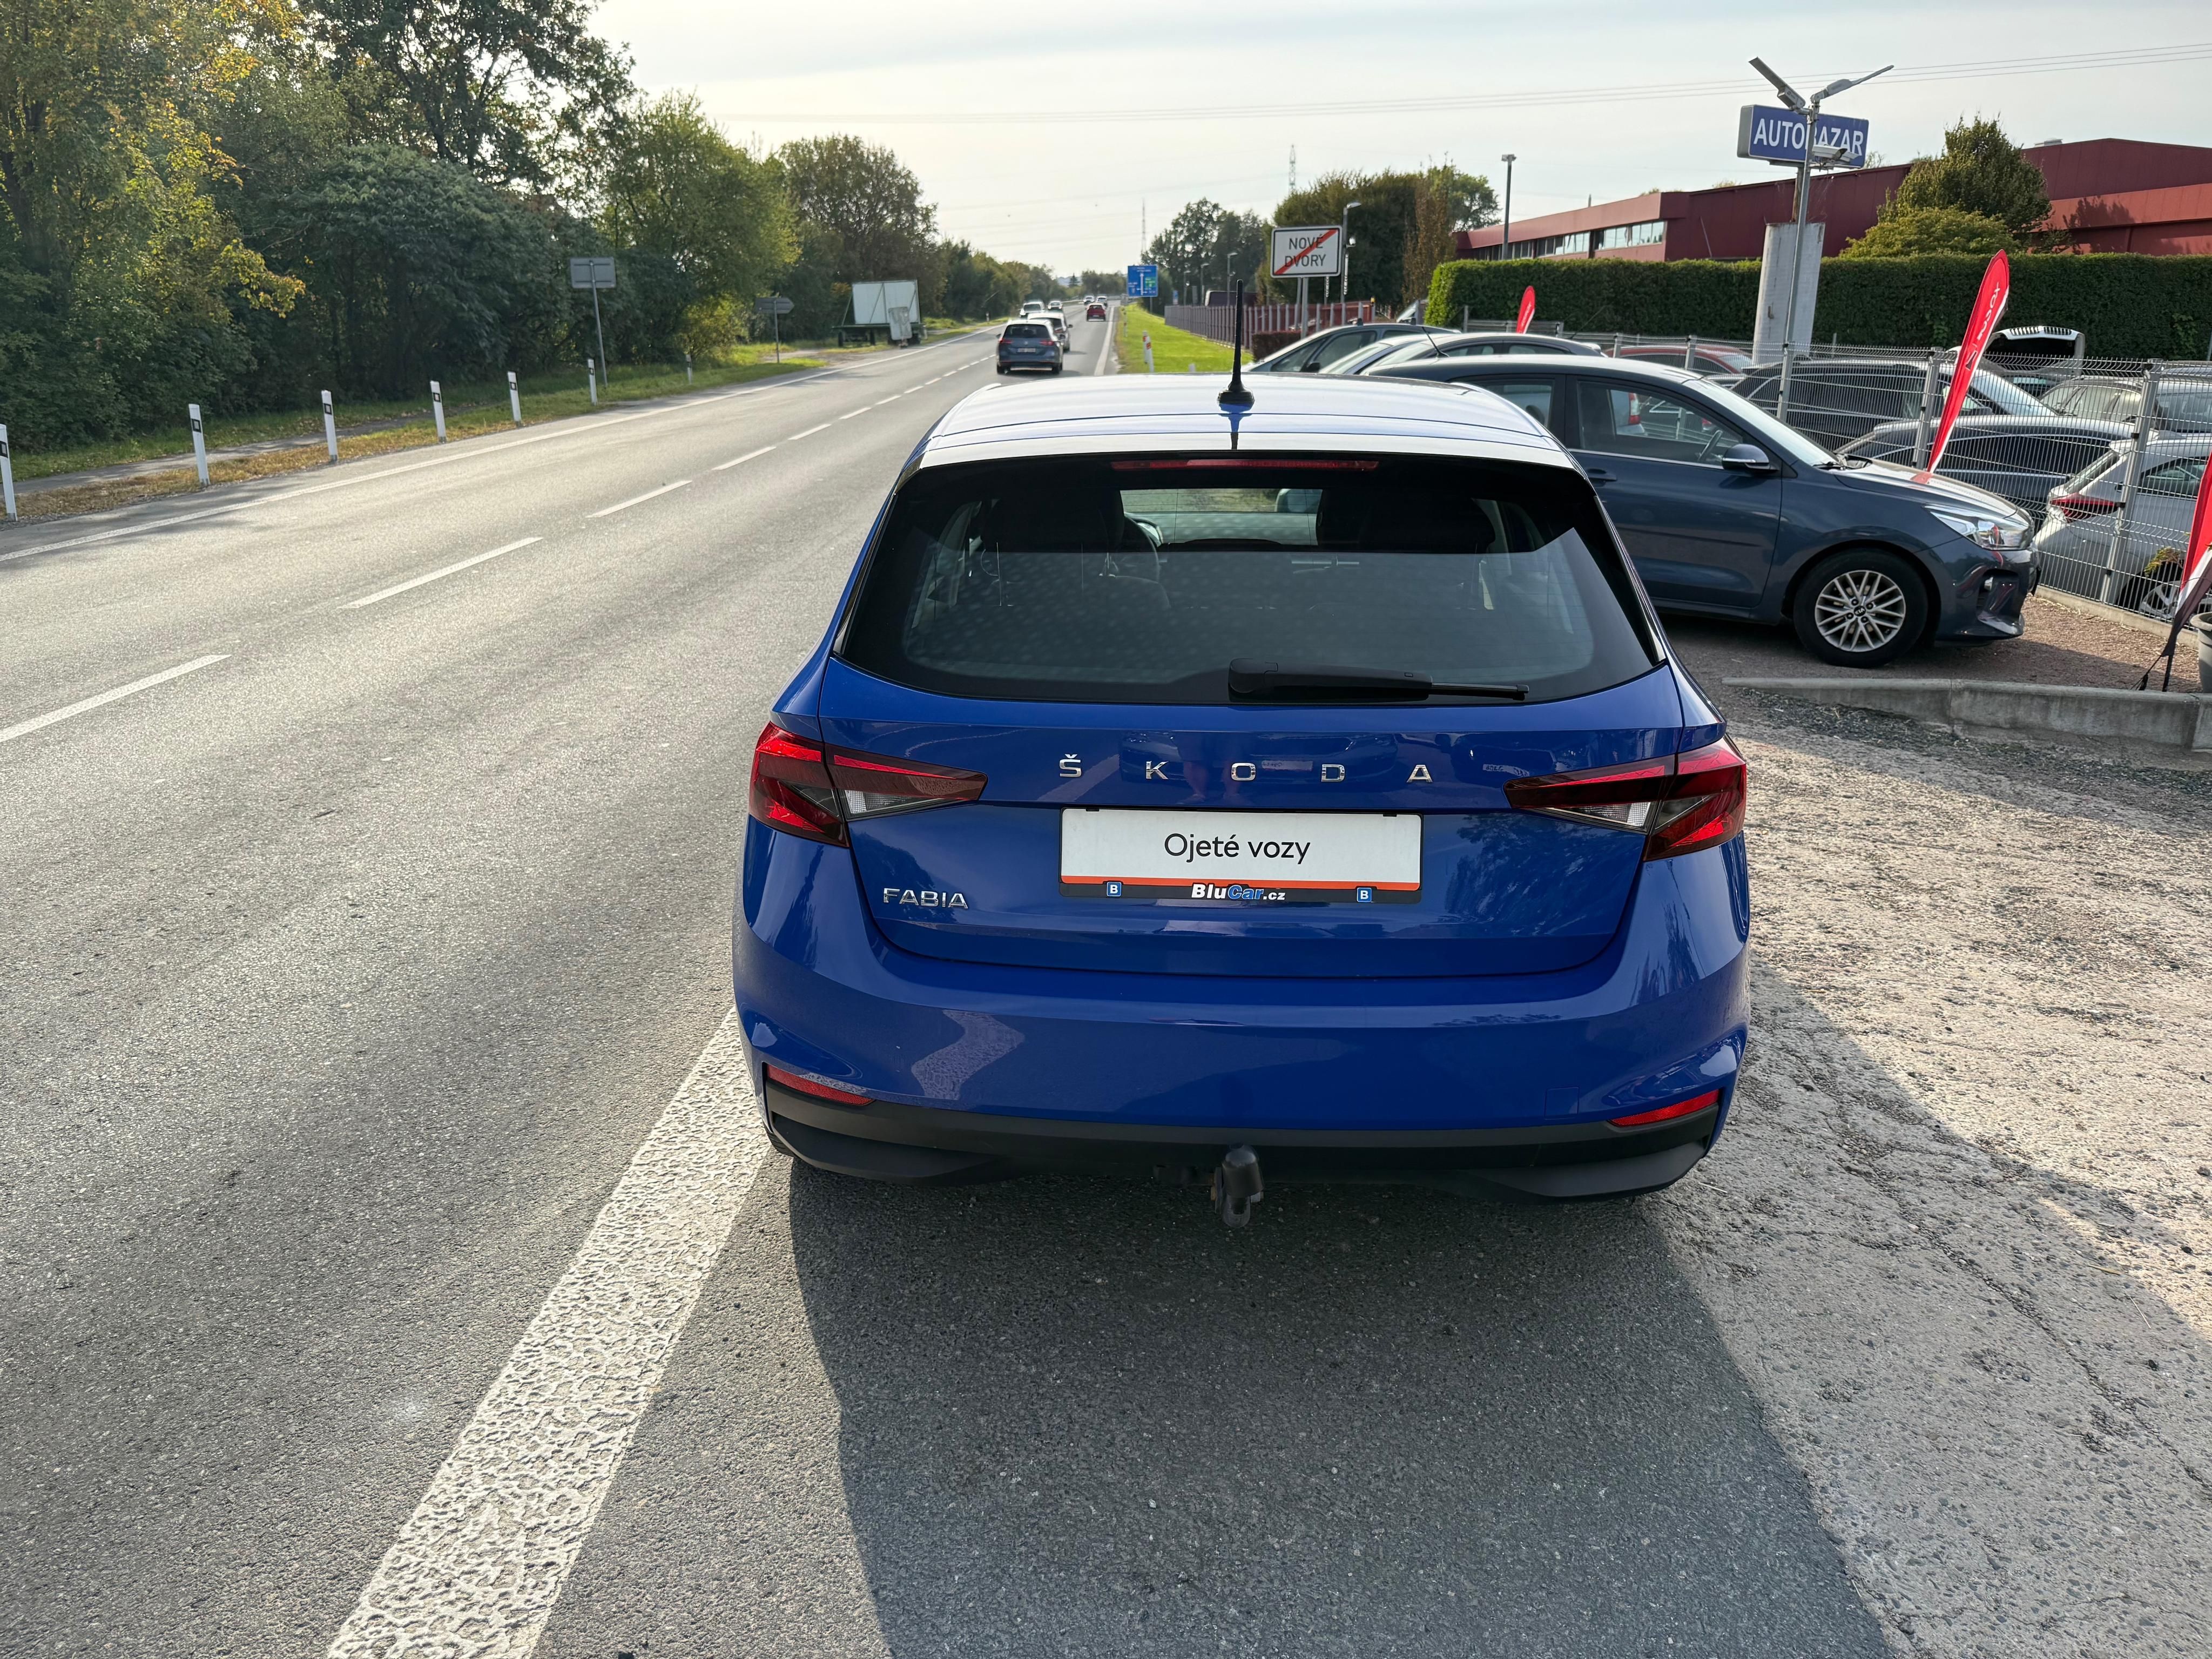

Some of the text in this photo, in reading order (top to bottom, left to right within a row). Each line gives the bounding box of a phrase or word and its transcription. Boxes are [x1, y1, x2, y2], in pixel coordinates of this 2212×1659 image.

[1289, 234, 1323, 249] NOVÉ
[1284, 254, 1326, 267] DVORY
[1164, 833, 1311, 865] Ojeté vozy
[1110, 884, 1118, 894] B
[1191, 883, 1286, 901] BluCar.cz
[1360, 890, 1368, 899] B
[883, 887, 968, 909] FABIA
